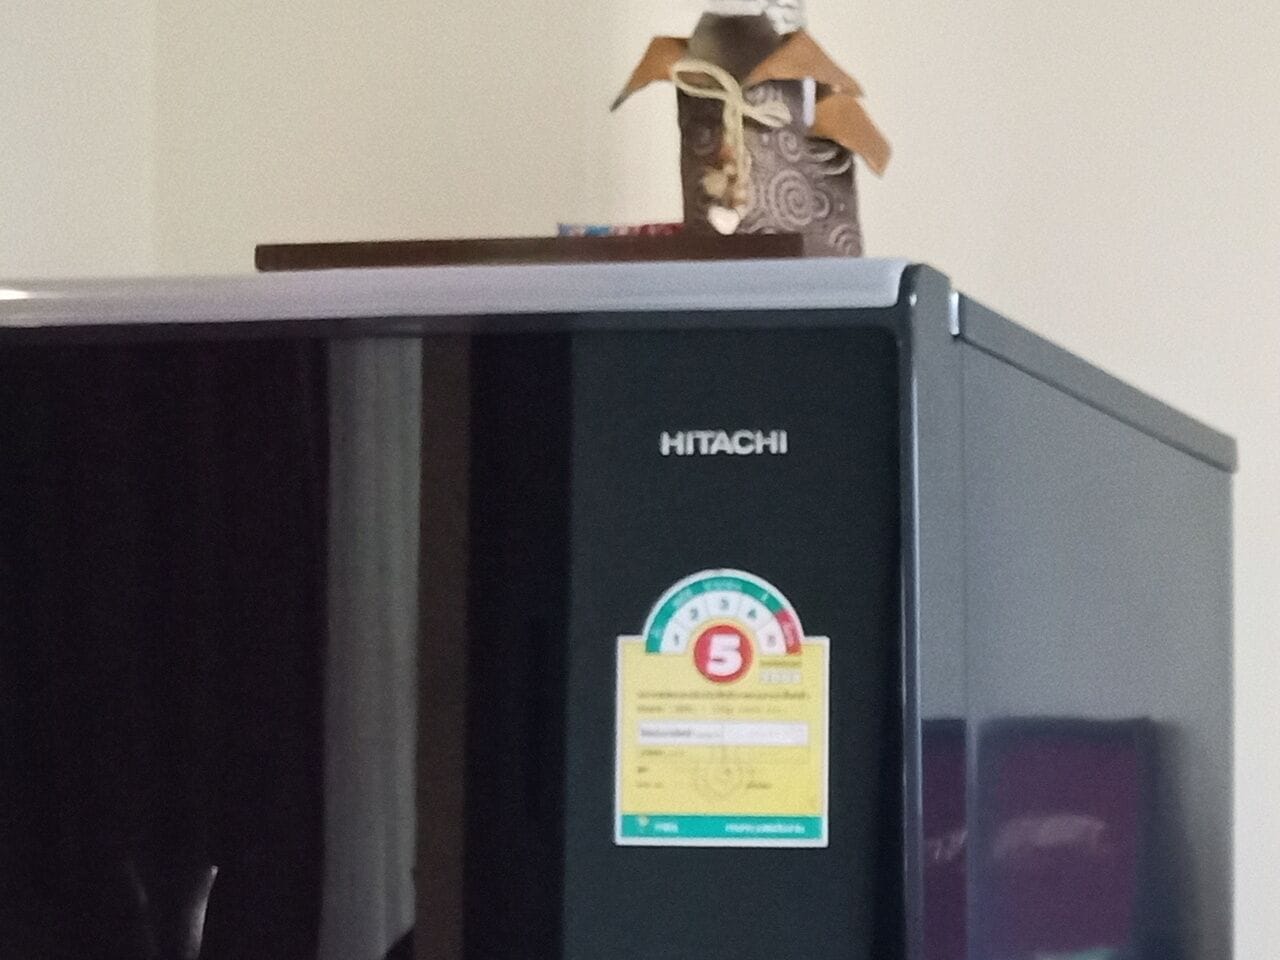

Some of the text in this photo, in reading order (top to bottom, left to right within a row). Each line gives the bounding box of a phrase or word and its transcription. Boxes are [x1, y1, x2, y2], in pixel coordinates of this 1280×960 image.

[660, 430, 788, 456] HITACHI
[746, 608, 757, 620] 4
[705, 633, 744, 676] 5
